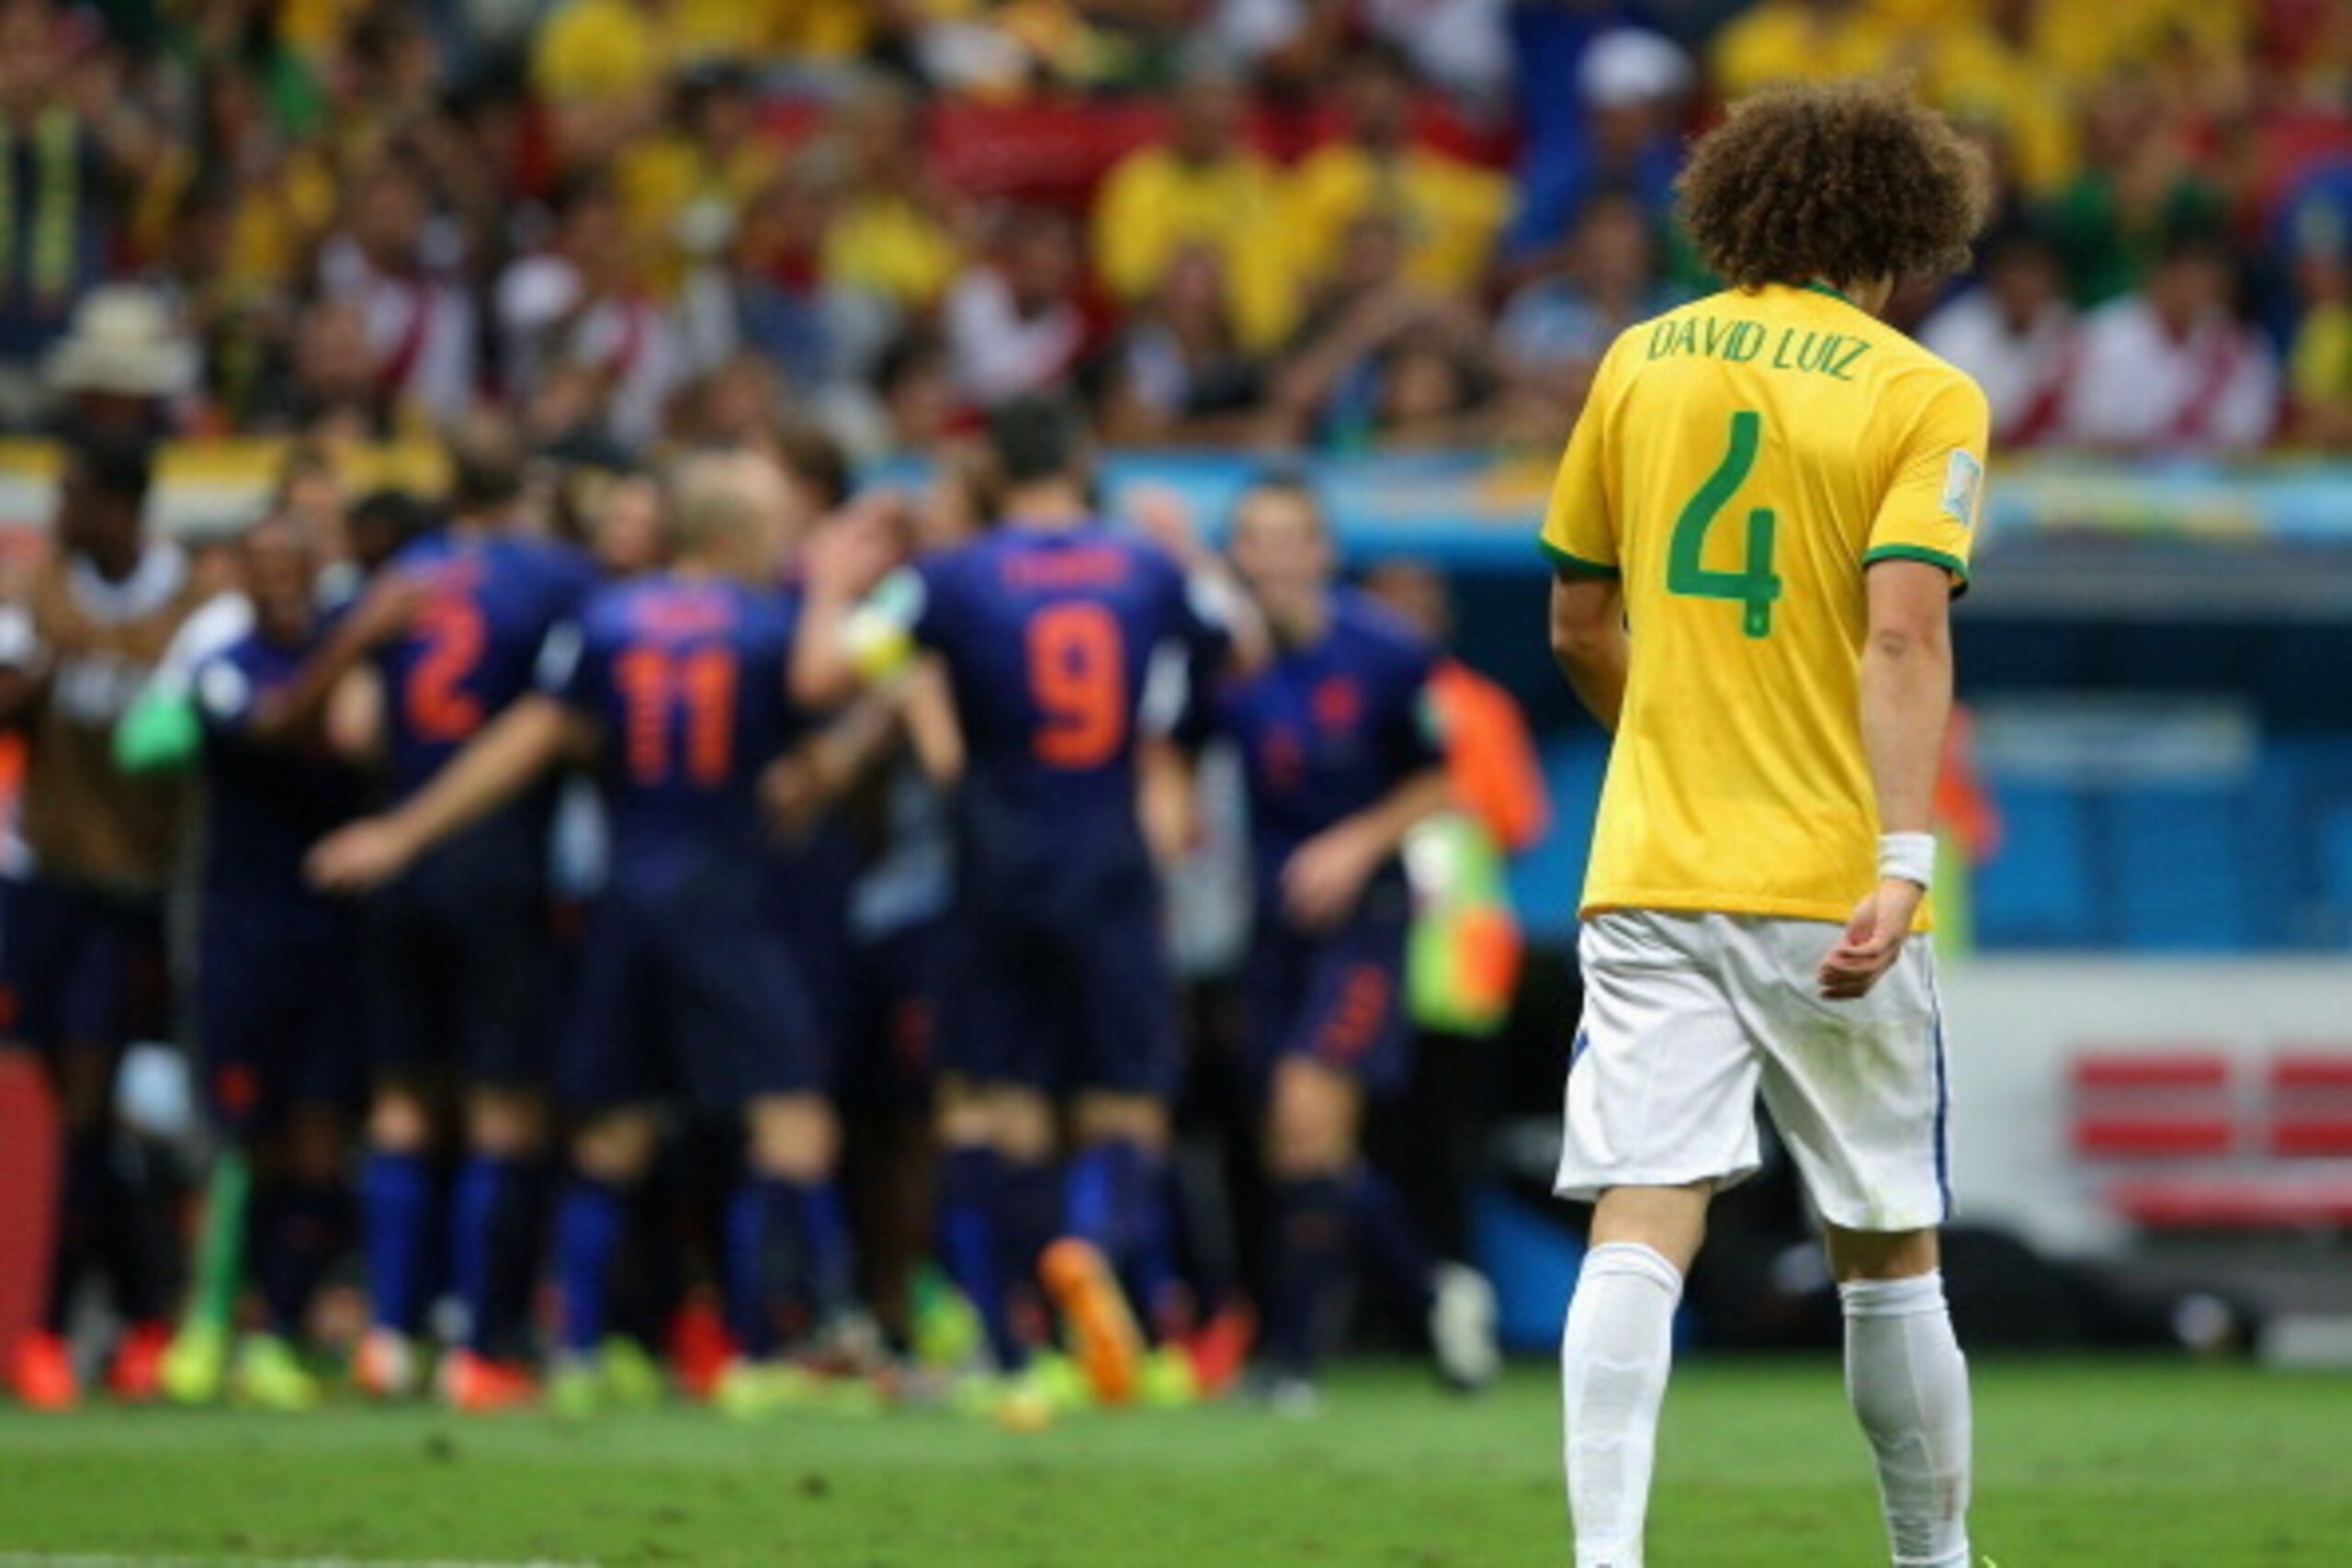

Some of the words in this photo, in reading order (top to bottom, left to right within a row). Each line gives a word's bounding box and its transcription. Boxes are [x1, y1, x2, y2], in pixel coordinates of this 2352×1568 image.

[1647, 316, 1766, 363] DAVID
[1772, 328, 1871, 381] LUIZ
[1667, 411, 1781, 637] 4
[406, 593, 487, 739] 2
[614, 645, 734, 784] 11
[1024, 601, 1126, 768] 9
